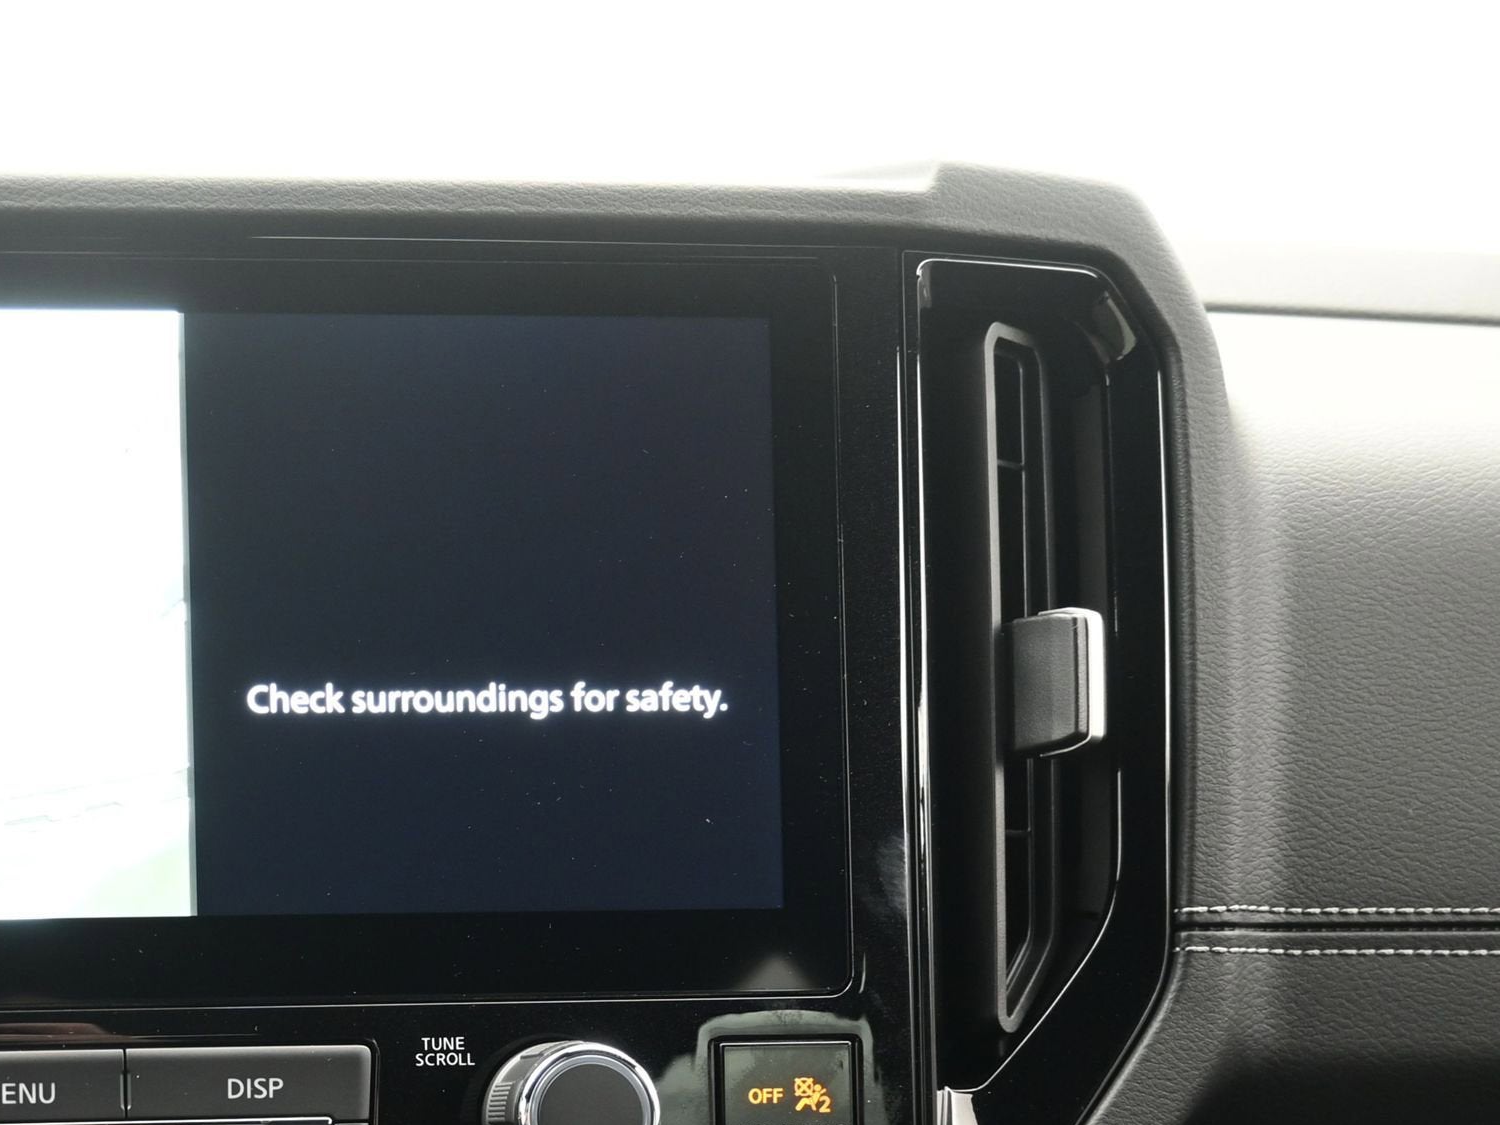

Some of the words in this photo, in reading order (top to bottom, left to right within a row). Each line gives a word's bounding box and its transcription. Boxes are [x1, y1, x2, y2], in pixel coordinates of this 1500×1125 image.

[246, 682, 346, 715] Check
[350, 681, 565, 721] surroundings
[569, 680, 621, 713] for
[625, 680, 729, 720] safety.
[421, 1036, 465, 1051] TUNE
[415, 1052, 476, 1067] SCROLL
[227, 1077, 284, 1099] DISP
[747, 1087, 784, 1105] OFF
